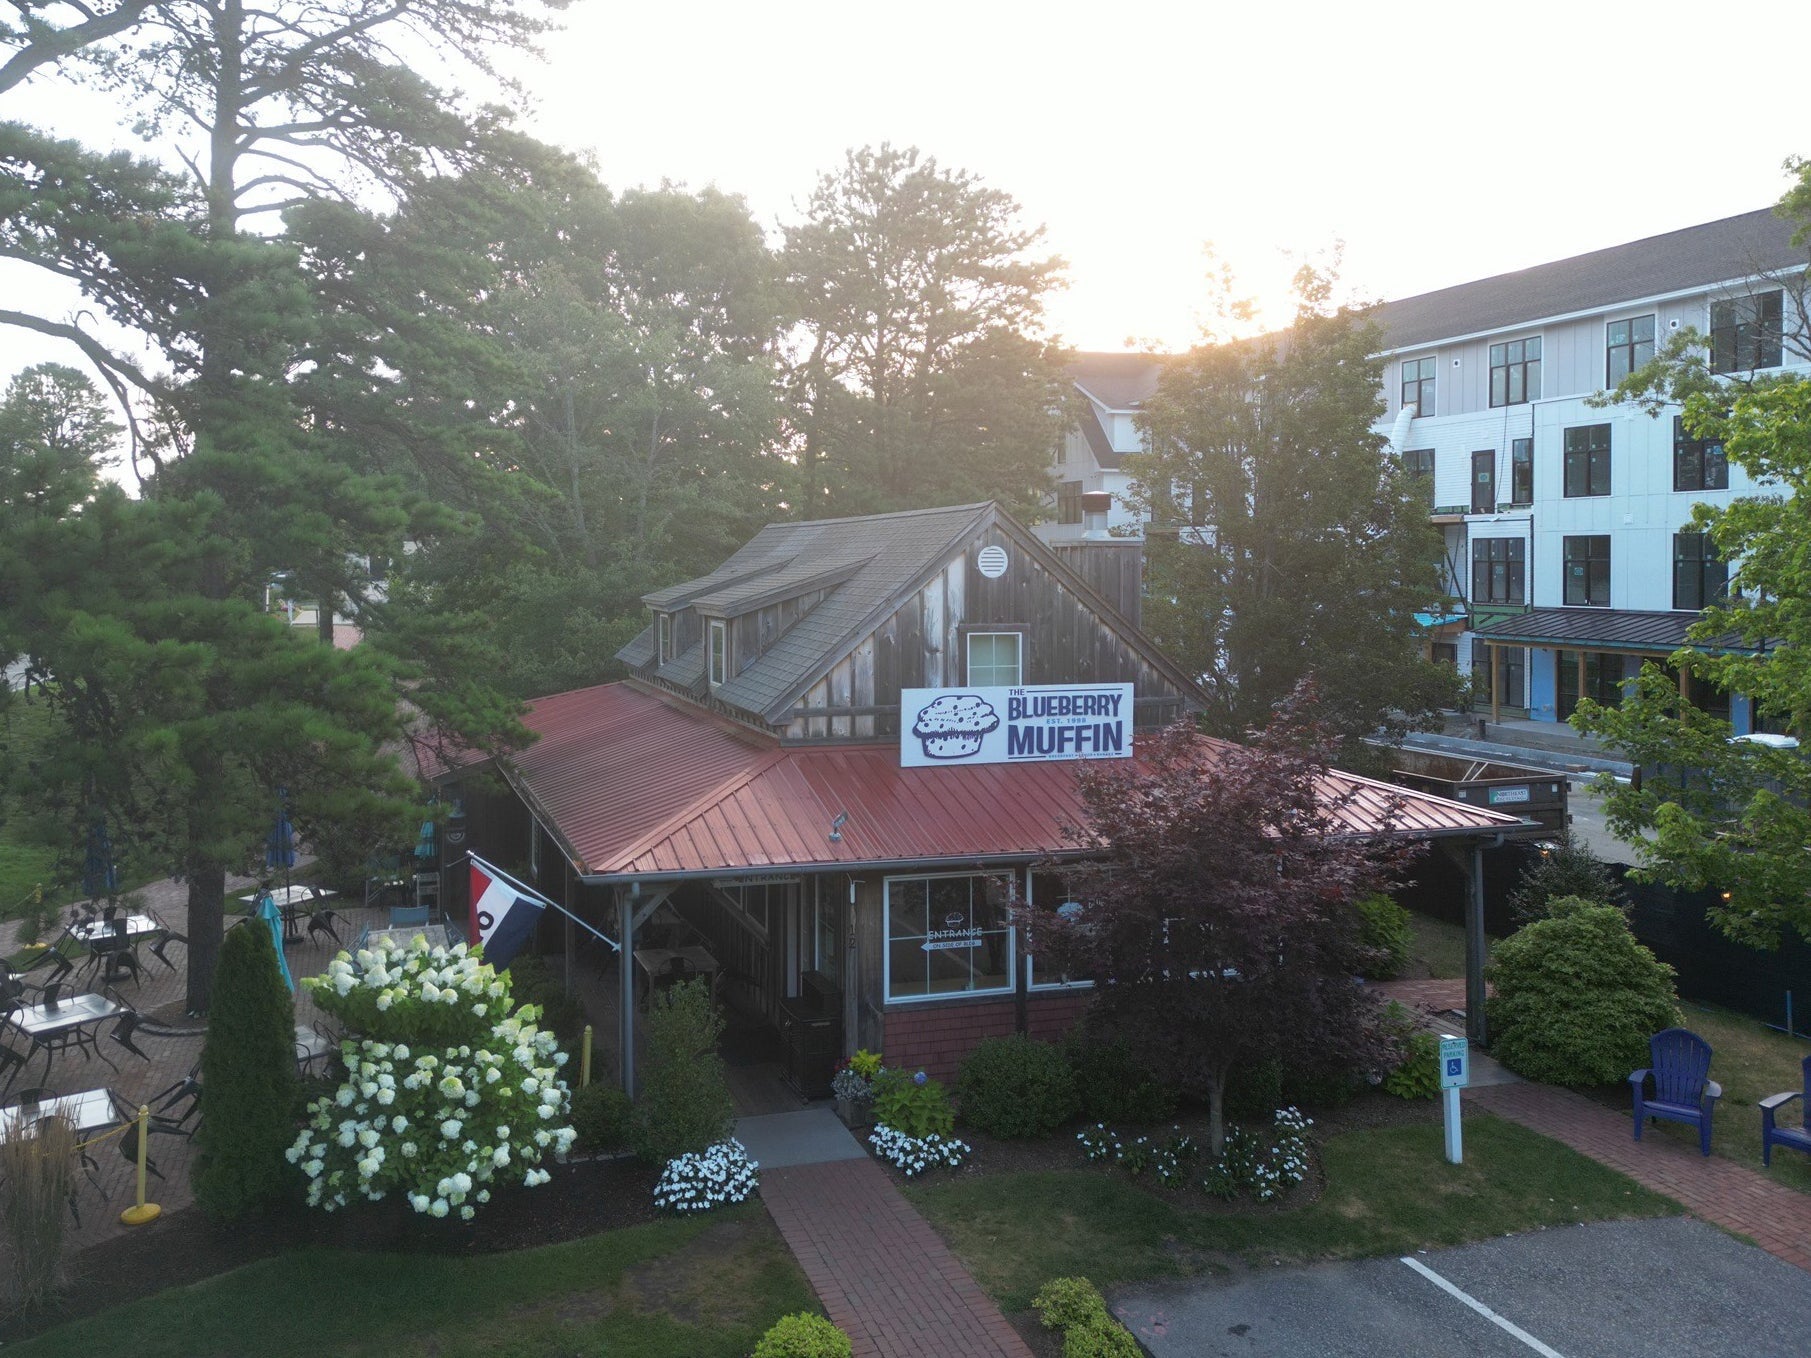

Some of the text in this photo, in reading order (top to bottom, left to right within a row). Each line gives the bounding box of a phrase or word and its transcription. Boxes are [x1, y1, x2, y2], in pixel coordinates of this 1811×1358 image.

[1009, 688, 1025, 696] THE
[1008, 694, 1122, 721] BLUEBERRY
[1008, 720, 1122, 755] MUFFIN
[928, 927, 983, 940] ENTRANCE
[1441, 1041, 1466, 1050] RESERVED
